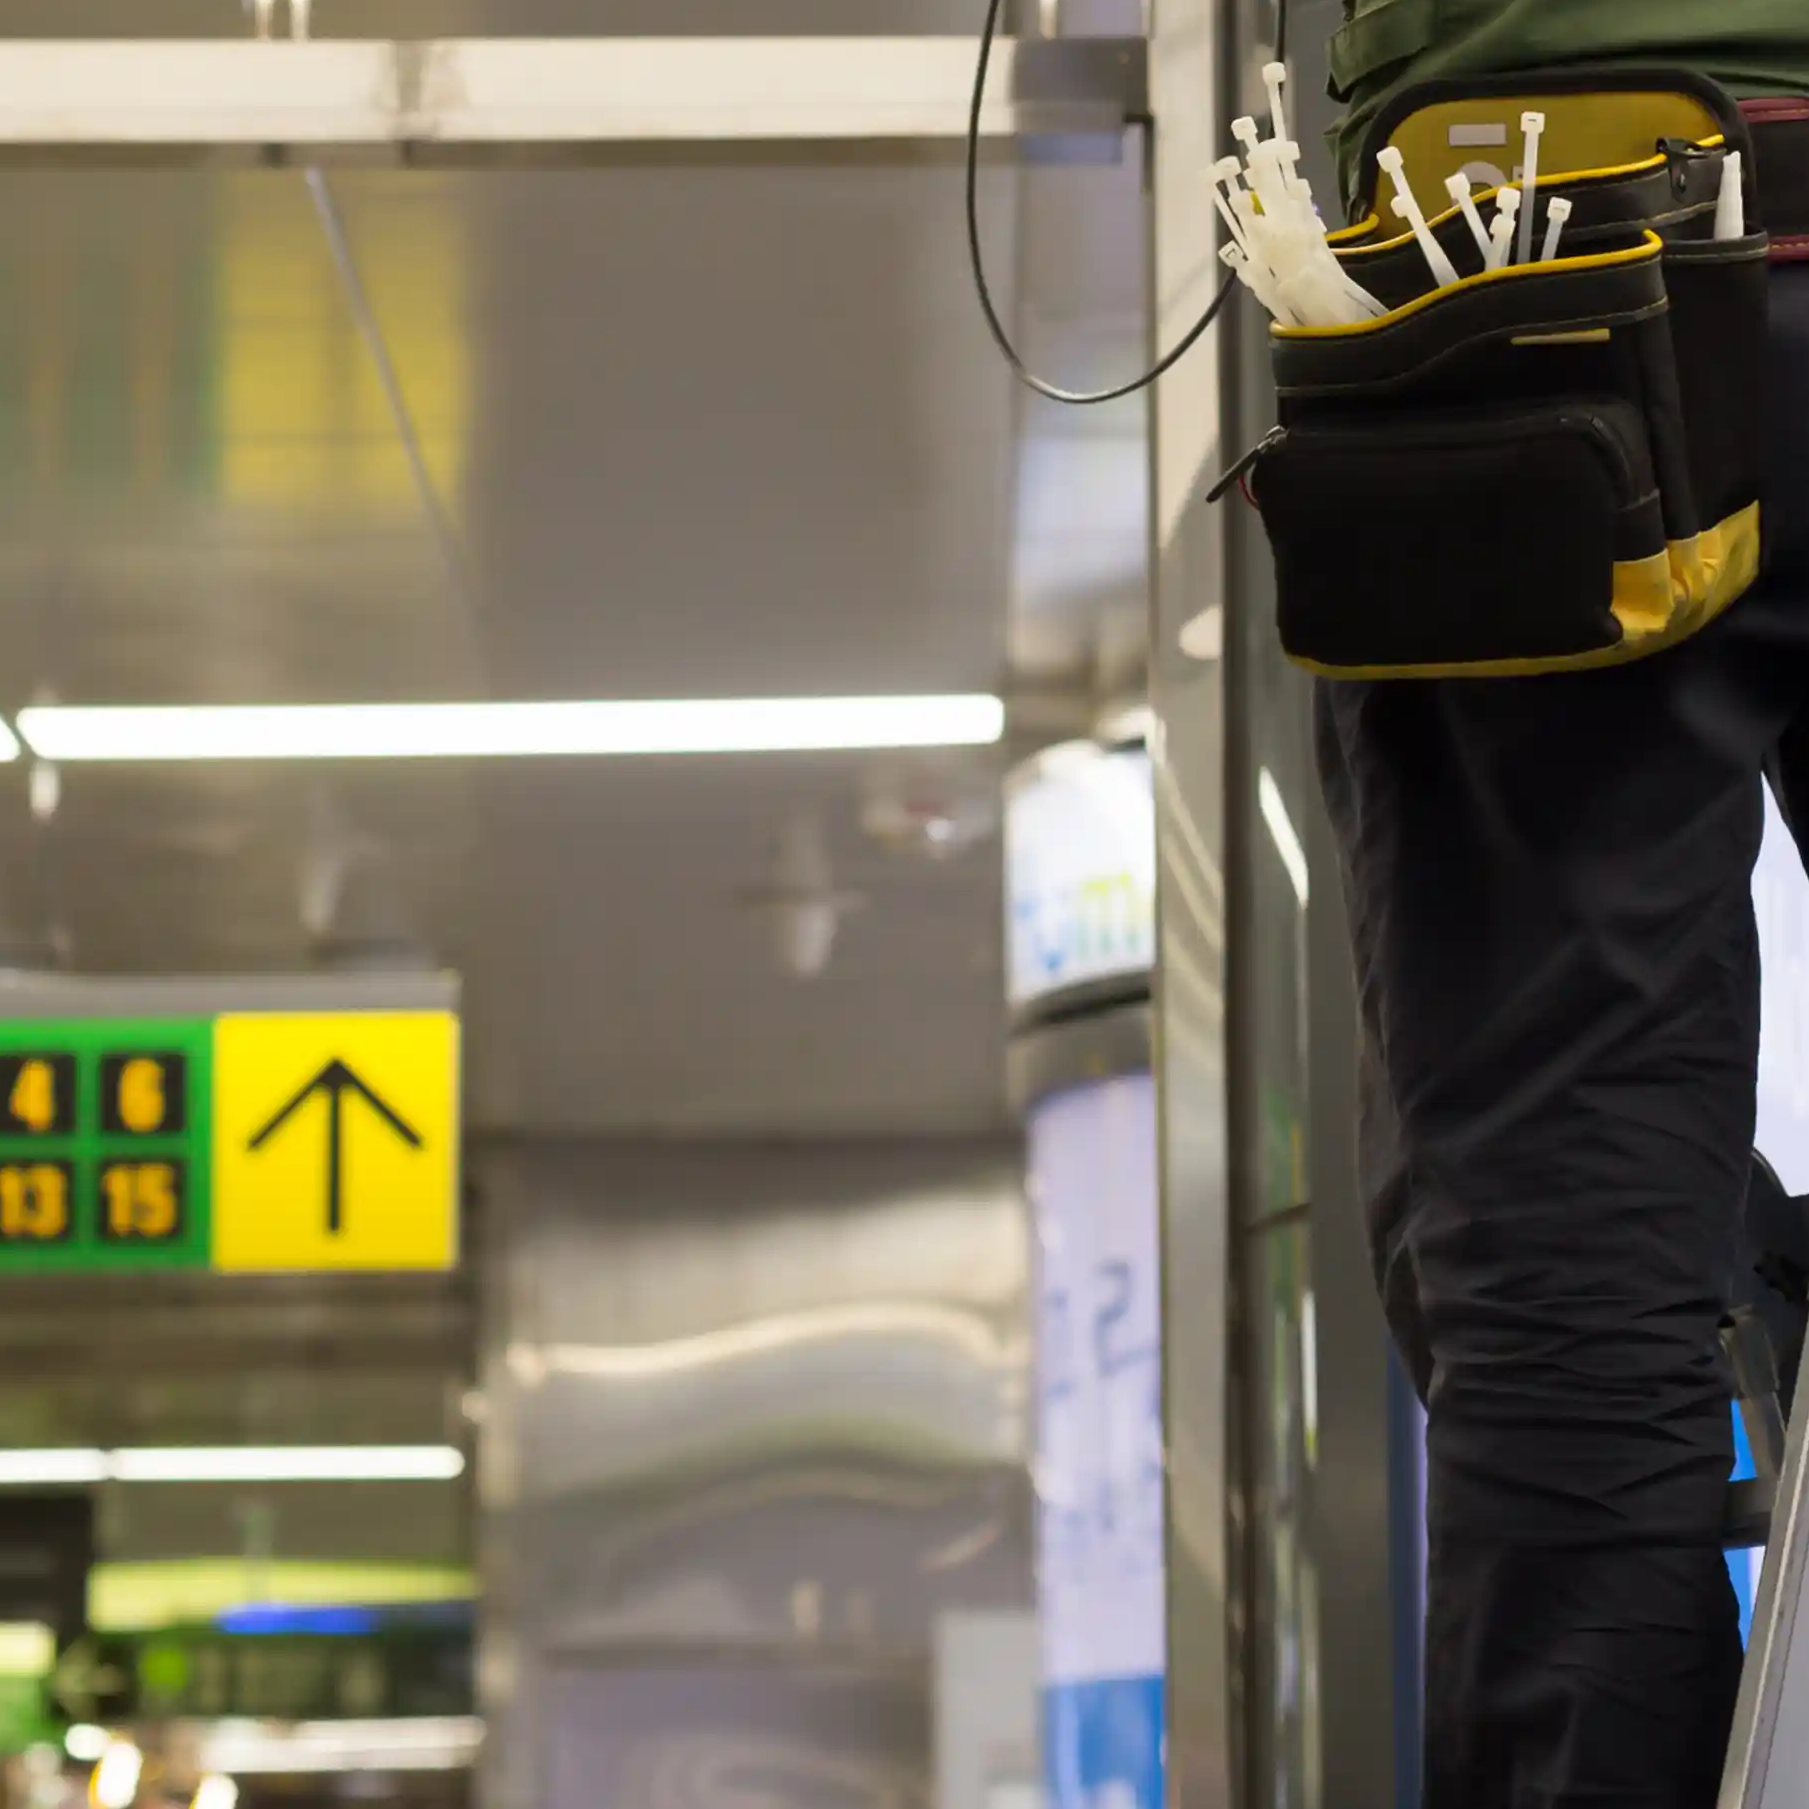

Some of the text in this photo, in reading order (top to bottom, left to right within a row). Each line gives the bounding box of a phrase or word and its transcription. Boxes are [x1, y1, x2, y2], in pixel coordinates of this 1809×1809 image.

[9, 1058, 55, 1133] 4
[116, 1057, 165, 1133] 6
[101, 1162, 176, 1237] 15
